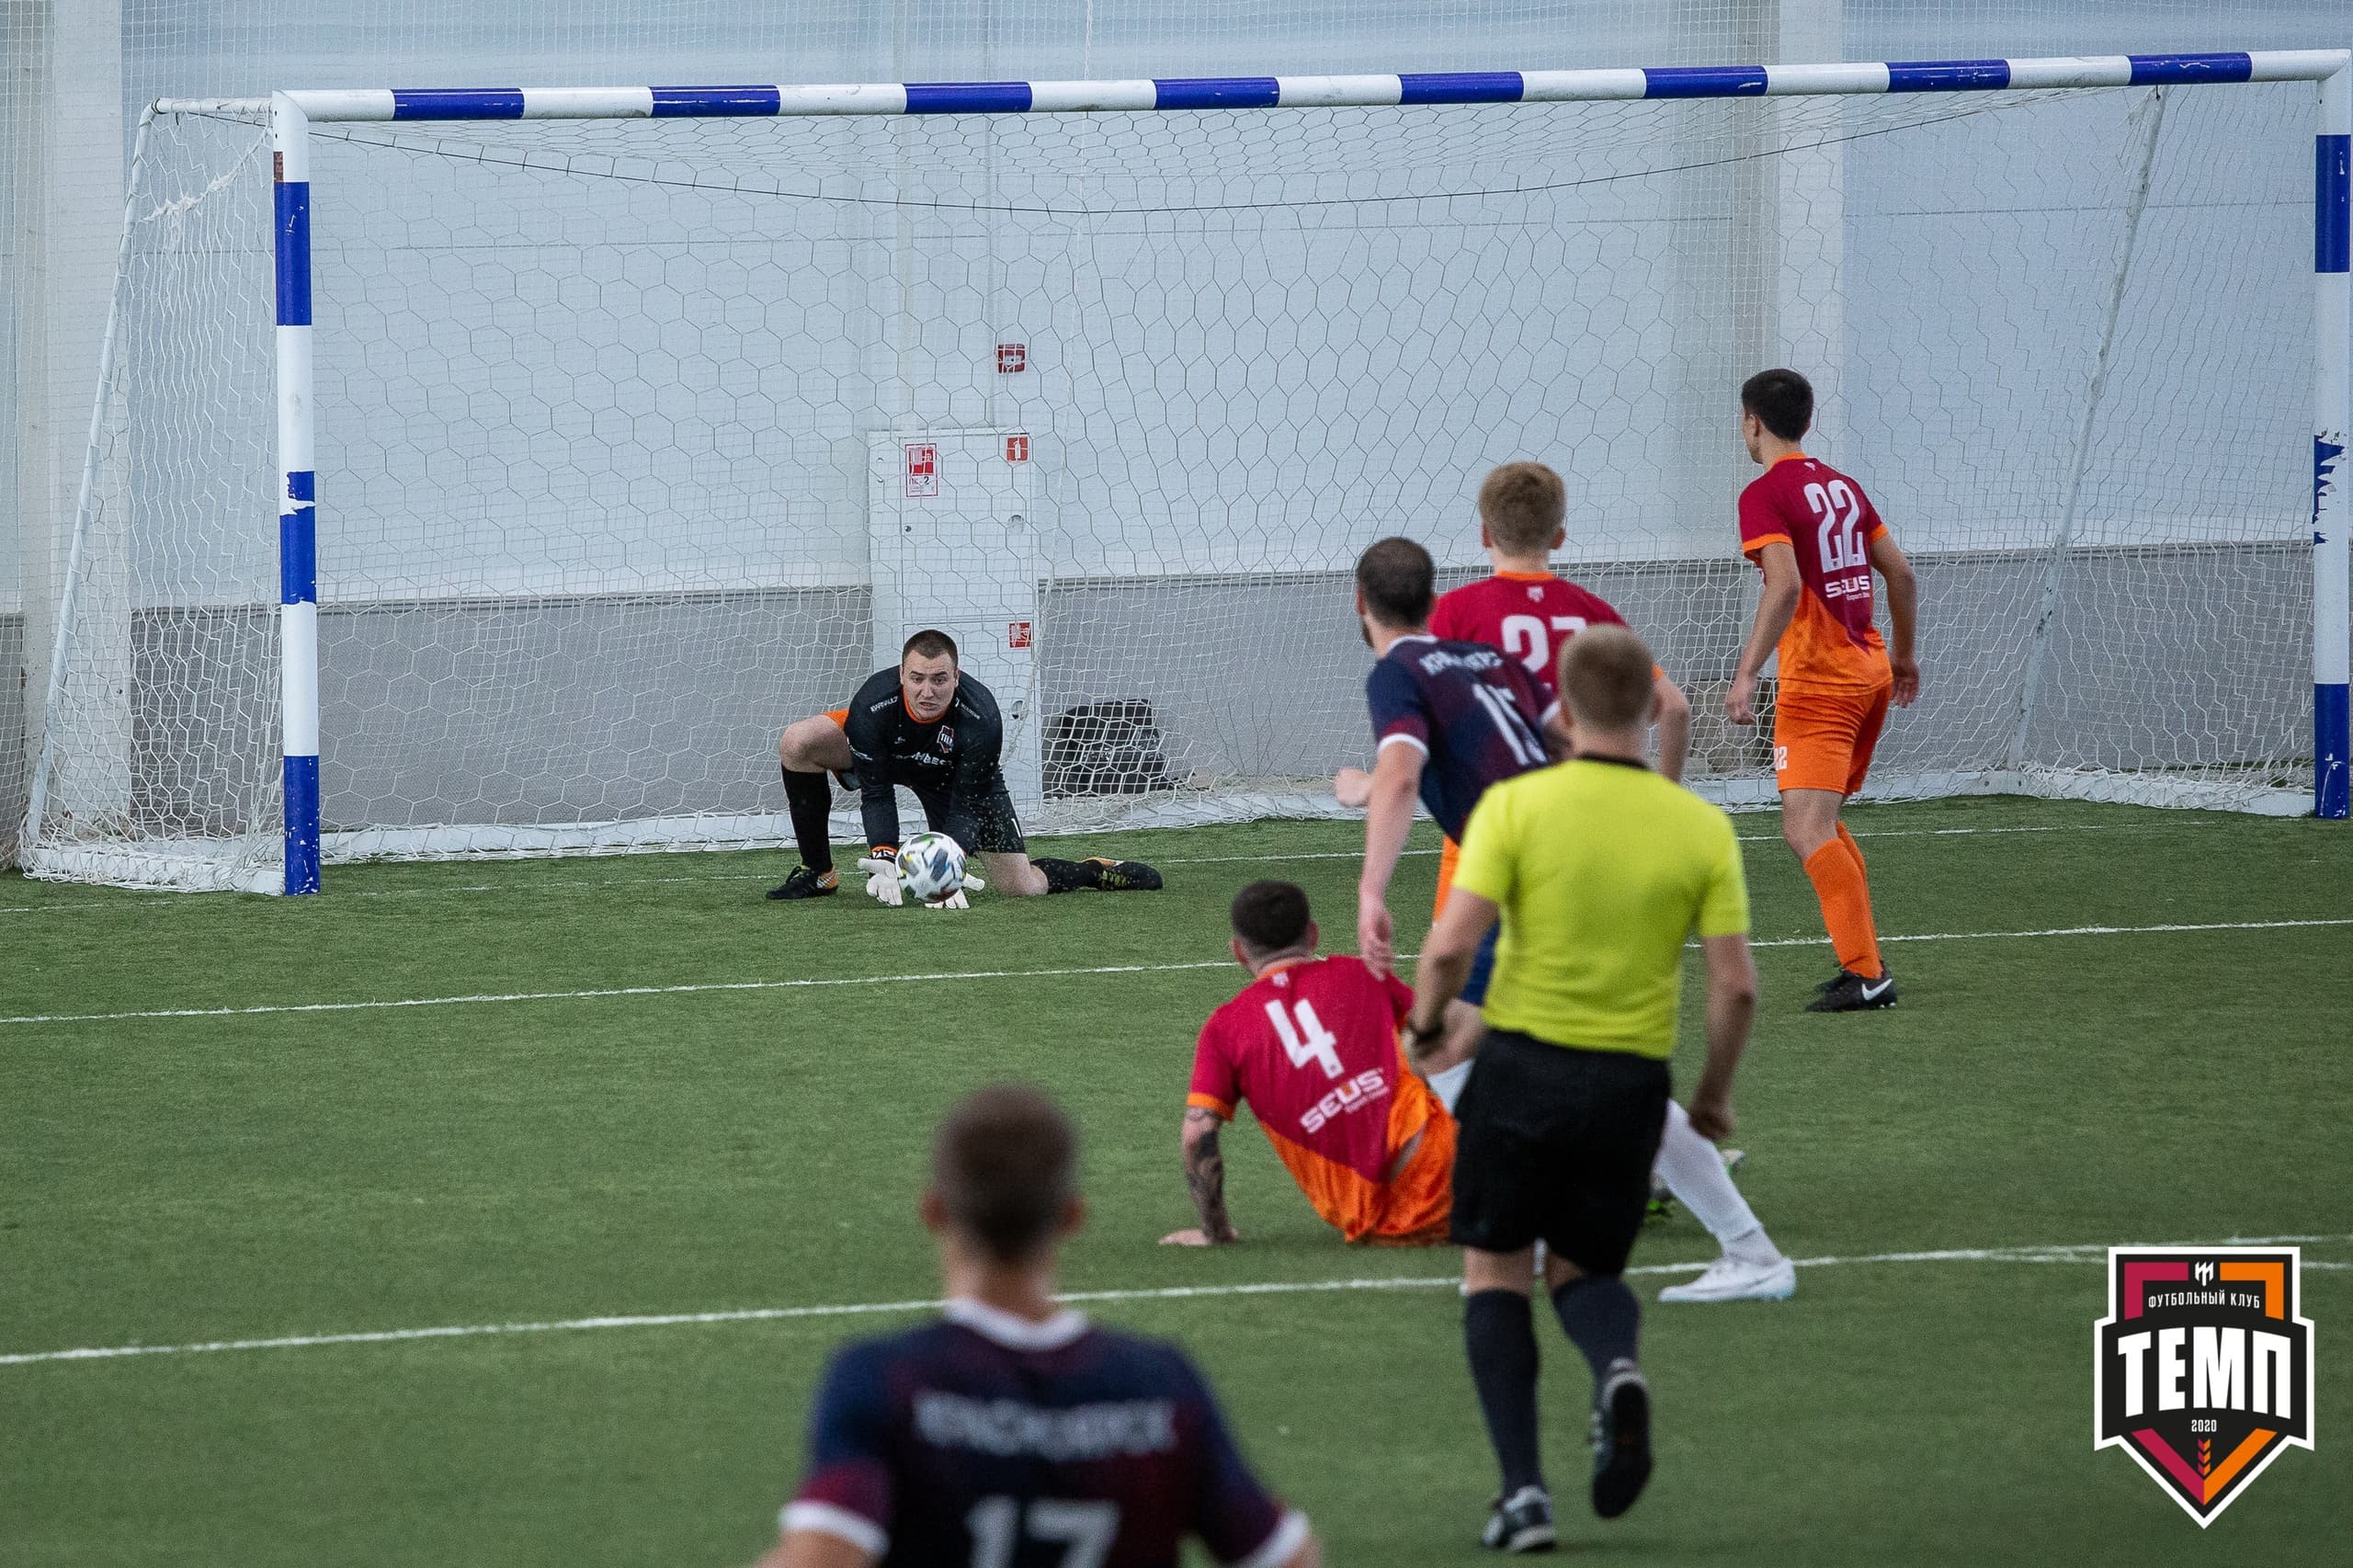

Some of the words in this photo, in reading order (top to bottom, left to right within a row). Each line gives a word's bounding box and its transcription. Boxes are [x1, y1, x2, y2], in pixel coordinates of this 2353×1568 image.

[1804, 480, 1868, 574] 22
[1824, 575, 1870, 598] SEUS
[1265, 998, 1345, 1080] 4
[1300, 1067, 1384, 1133] SEUS
